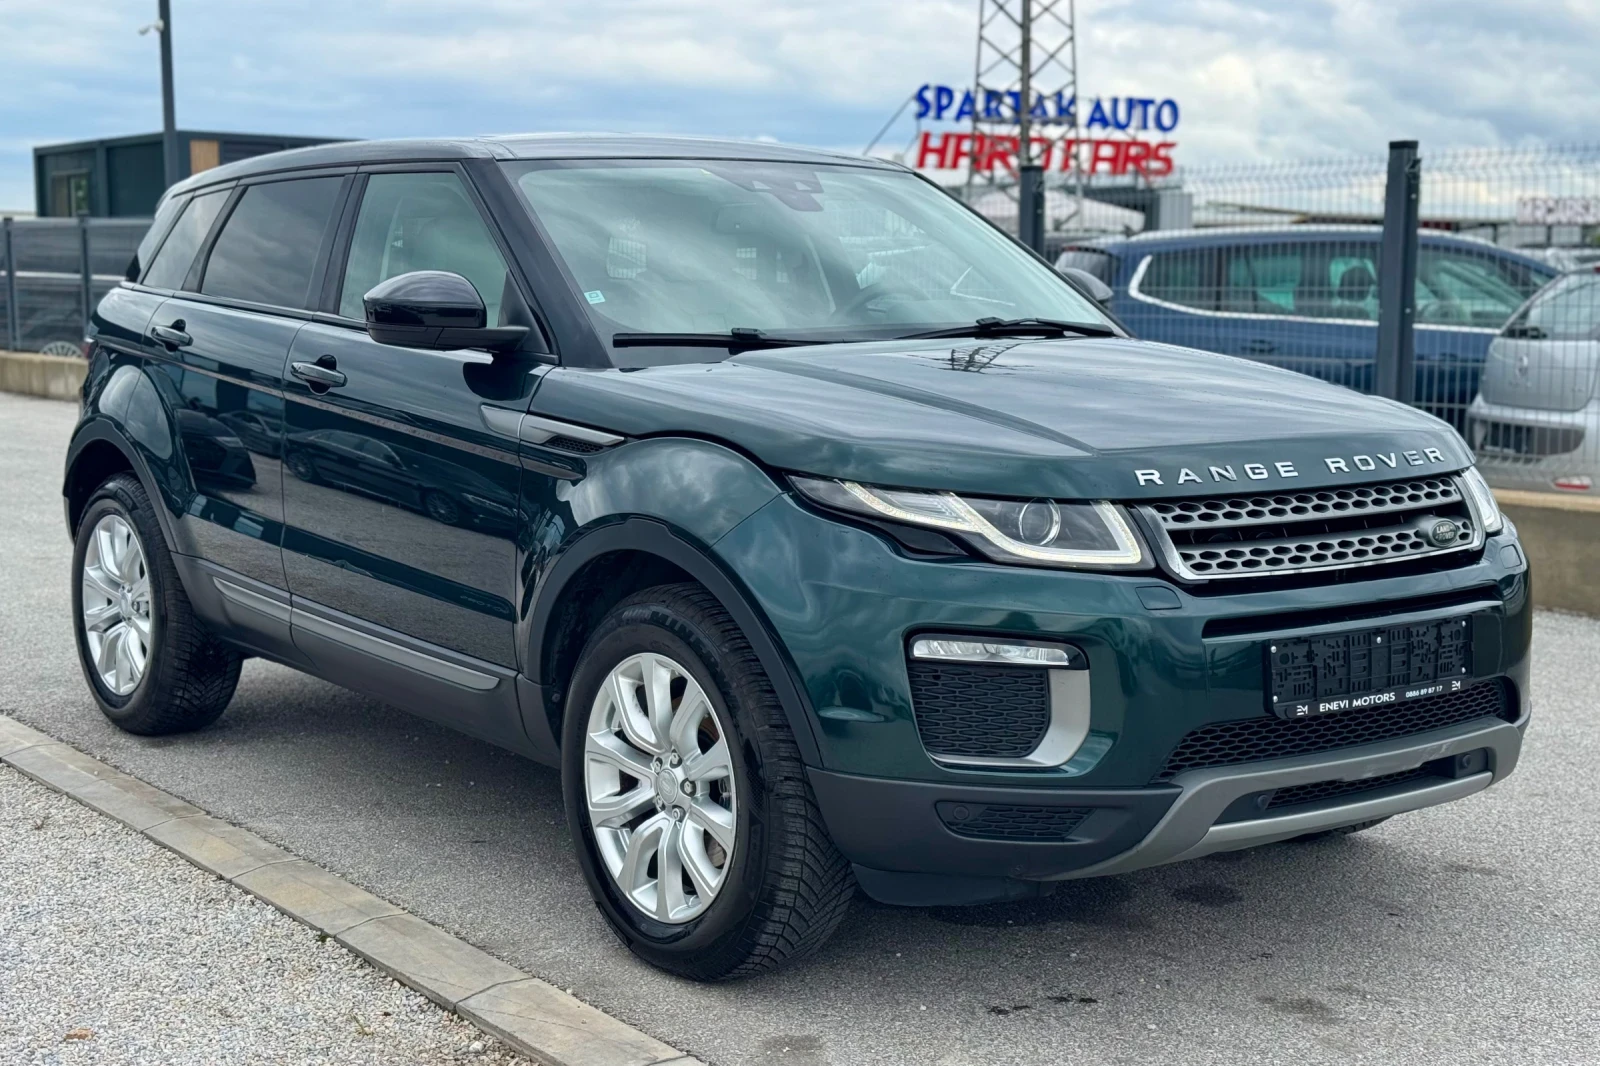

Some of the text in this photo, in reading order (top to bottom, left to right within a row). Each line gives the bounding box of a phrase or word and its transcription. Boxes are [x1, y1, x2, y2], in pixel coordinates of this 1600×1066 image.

[915, 84, 1180, 132] SPARTAK AUTO
[1060, 138, 1178, 184] CARS
[1134, 447, 1446, 487] RANGE ROVER
[1319, 699, 1349, 712] ENEVI
[1352, 692, 1396, 707] MOTORS
[1405, 690, 1420, 698] 0886
